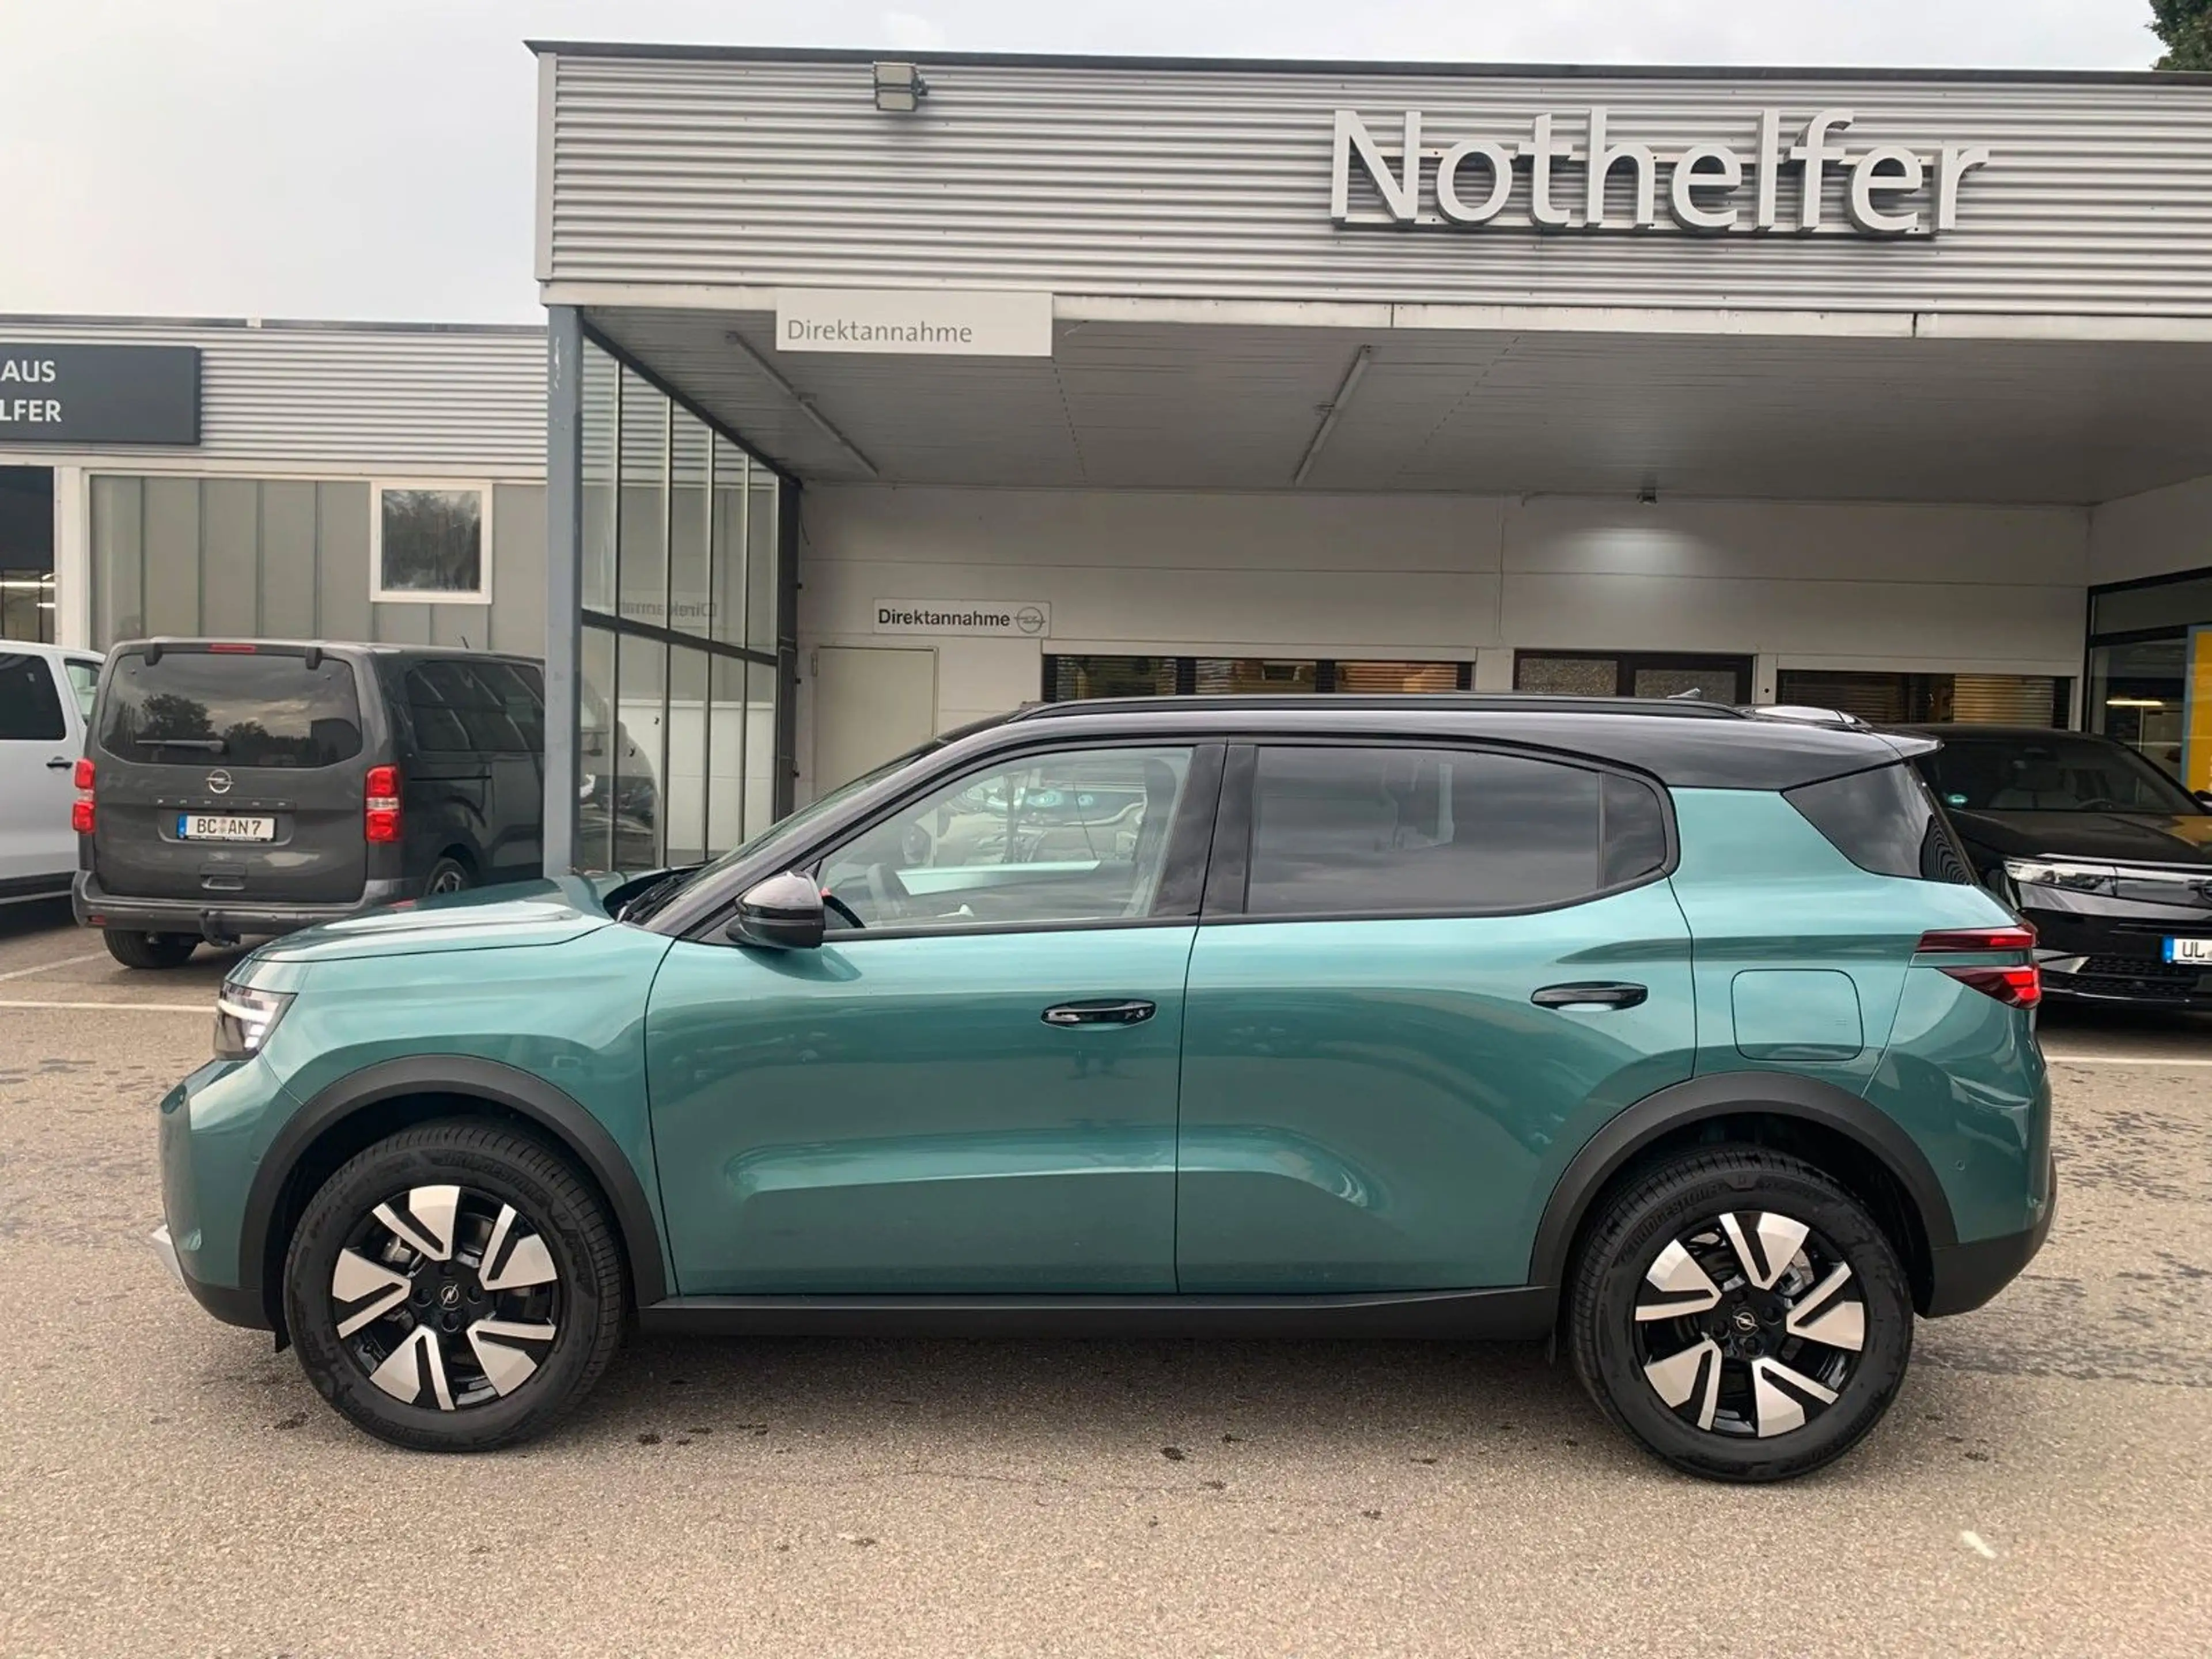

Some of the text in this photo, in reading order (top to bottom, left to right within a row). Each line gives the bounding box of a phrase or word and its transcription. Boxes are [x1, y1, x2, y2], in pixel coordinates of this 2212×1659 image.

[1331, 107, 1988, 232] Nothelfer
[787, 319, 972, 343] Direktannahme
[0, 359, 56, 382] AUS
[0, 399, 62, 422] LFER
[878, 608, 1010, 626] Direktannahme
[197, 818, 217, 834] BC
[228, 819, 248, 835] AN
[2182, 941, 2205, 958] UL
